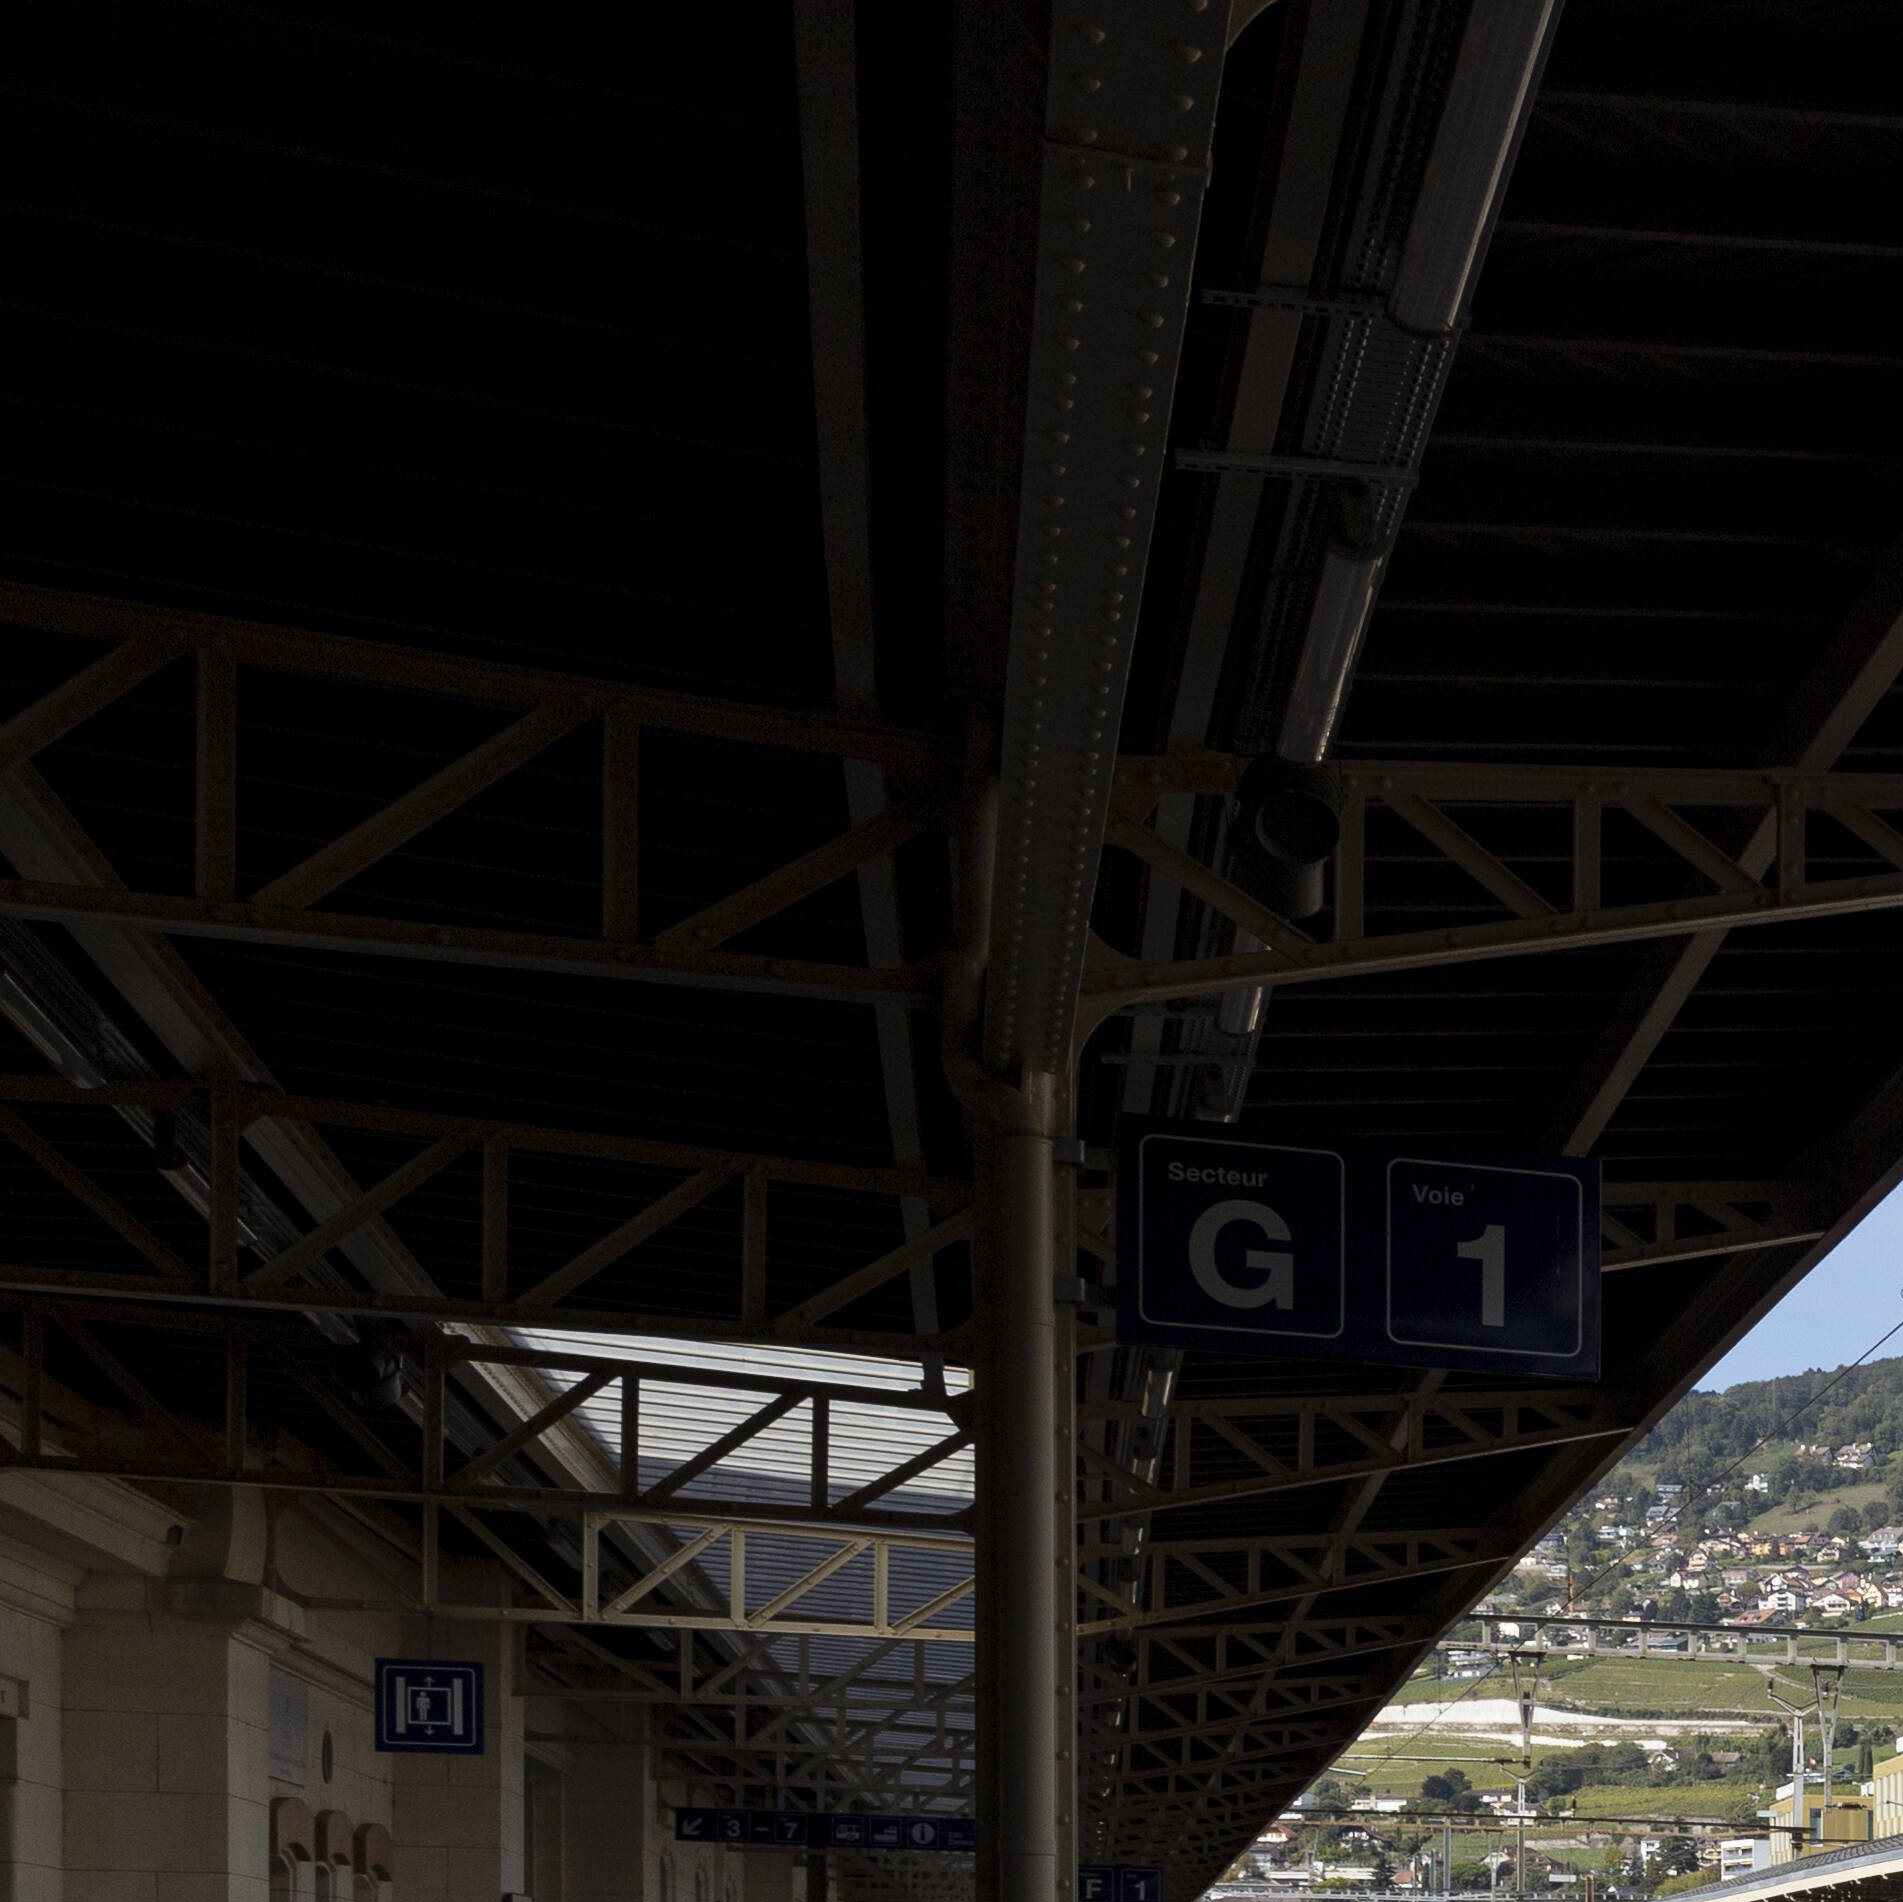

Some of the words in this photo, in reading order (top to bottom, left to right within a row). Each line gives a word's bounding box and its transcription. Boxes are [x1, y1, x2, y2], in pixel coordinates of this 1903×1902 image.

[1166, 1161, 1269, 1189] Secteur
[1412, 1184, 1466, 1207] Voie
[1188, 1198, 1295, 1311] G
[1456, 1223, 1507, 1328] 1
[724, 1821, 741, 1838] 3
[783, 1822, 799, 1839] 7
[1085, 1879, 1104, 1900] F
[1134, 1880, 1146, 1901] 1
